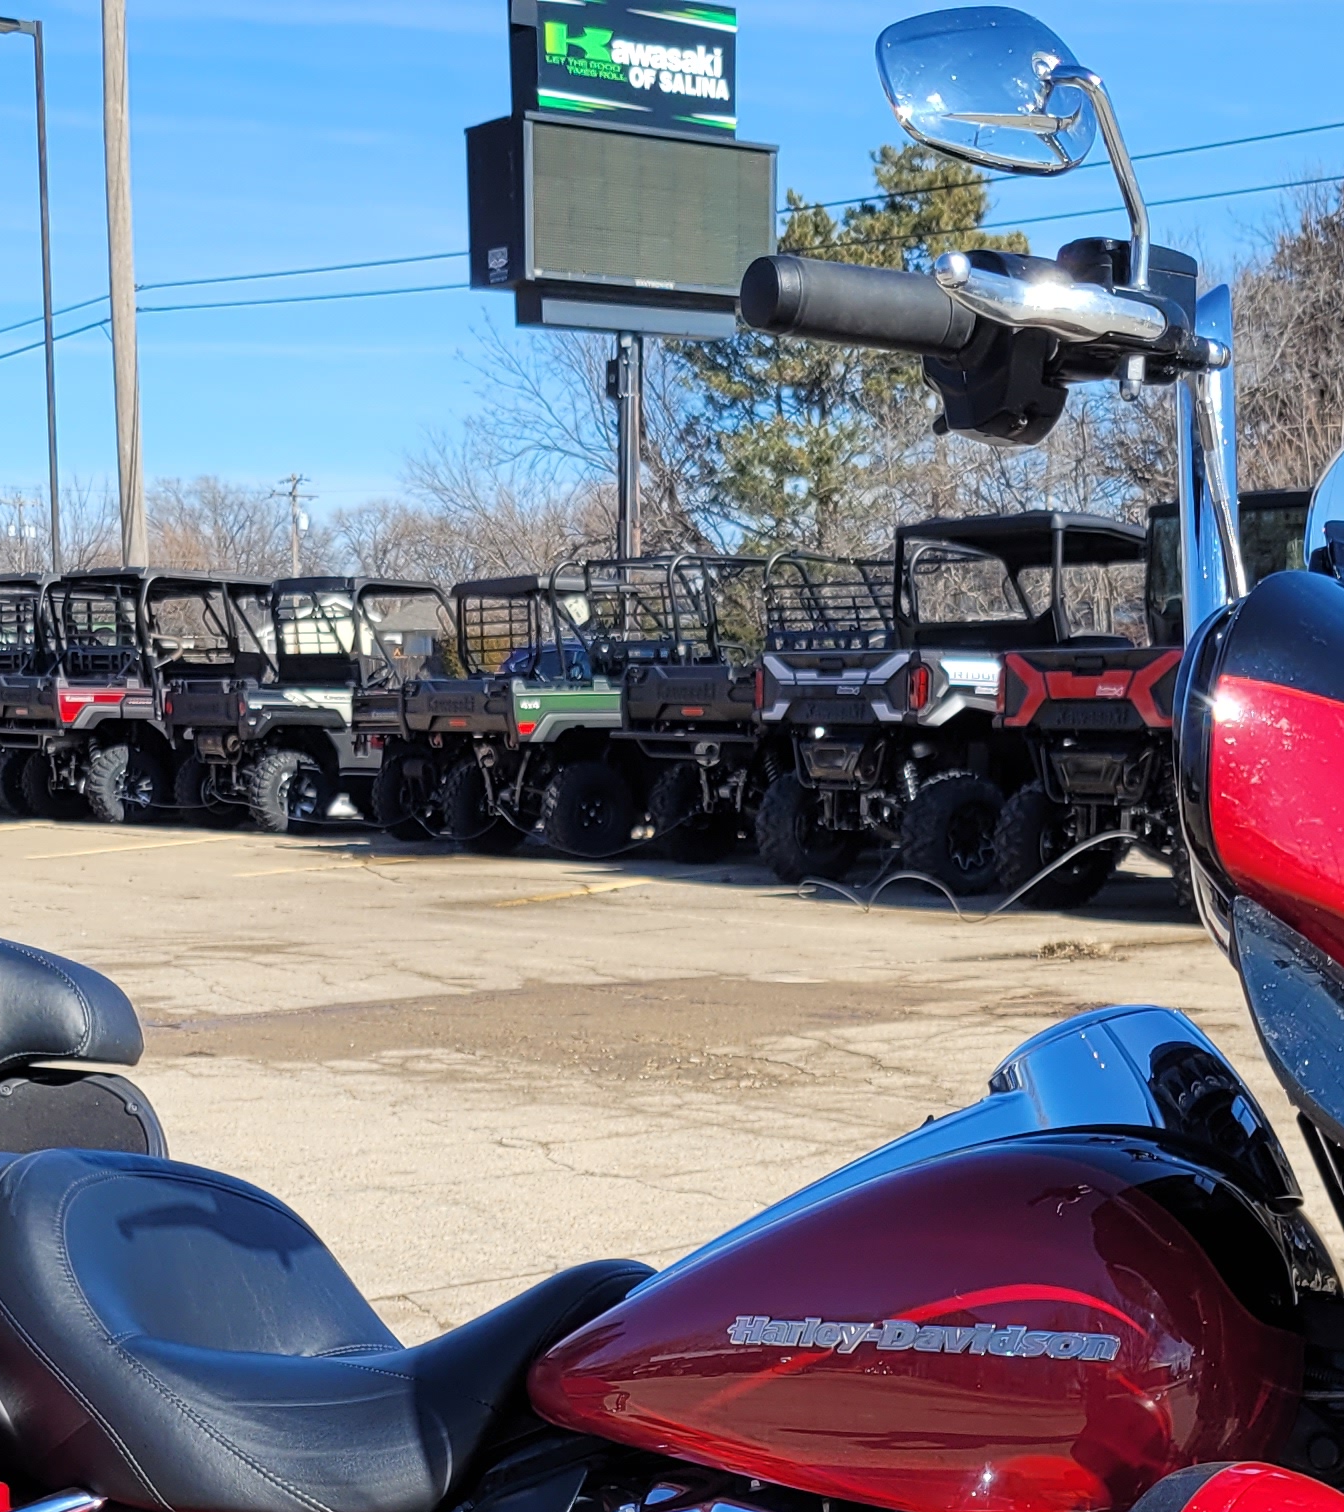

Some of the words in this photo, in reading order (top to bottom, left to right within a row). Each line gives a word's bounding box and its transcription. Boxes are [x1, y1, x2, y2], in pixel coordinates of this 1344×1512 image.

[544, 21, 724, 79] Kawasaki
[567, 57, 588, 68] THE
[628, 66, 657, 90] OF
[658, 71, 730, 101] SALINA
[727, 1315, 1121, 1362] Harley-Davidson
